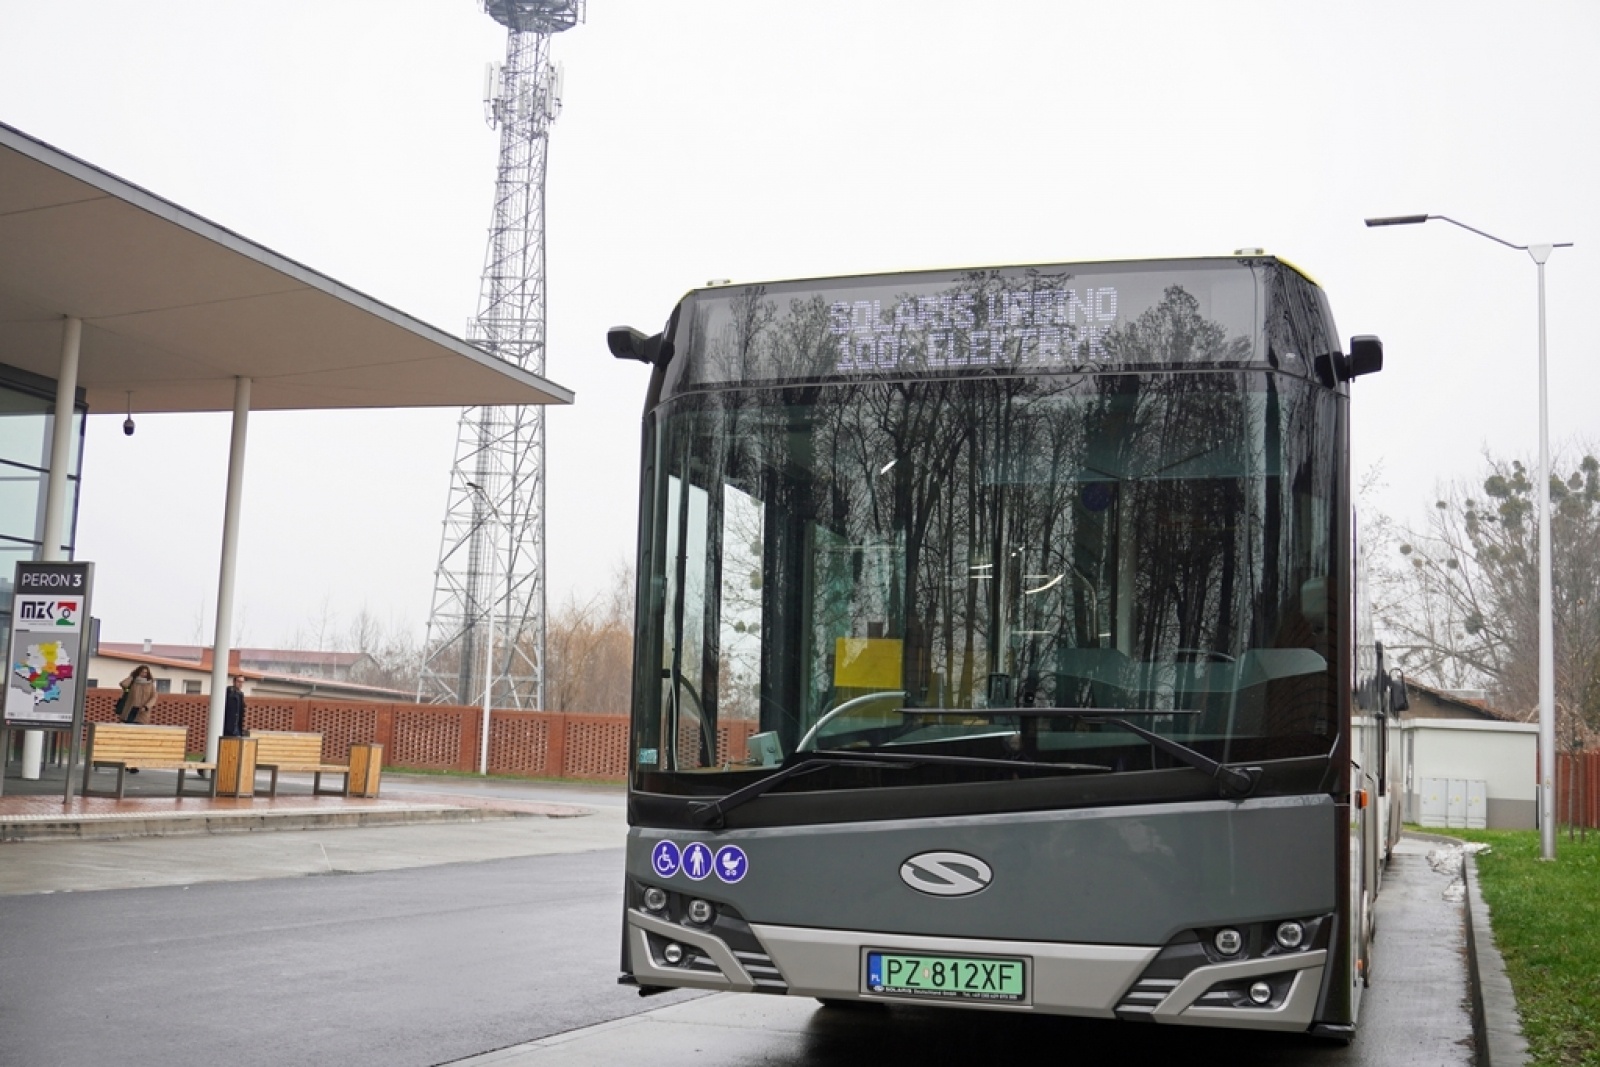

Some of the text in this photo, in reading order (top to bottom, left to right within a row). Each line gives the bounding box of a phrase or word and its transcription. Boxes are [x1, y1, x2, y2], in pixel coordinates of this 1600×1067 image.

[830, 287, 1117, 334] SOLARIS URBINO
[928, 324, 1111, 366] ELEKTRYK
[22, 573, 82, 587] PERON 3
[871, 974, 880, 982] PL
[887, 959, 1015, 991] PZ 812XF
